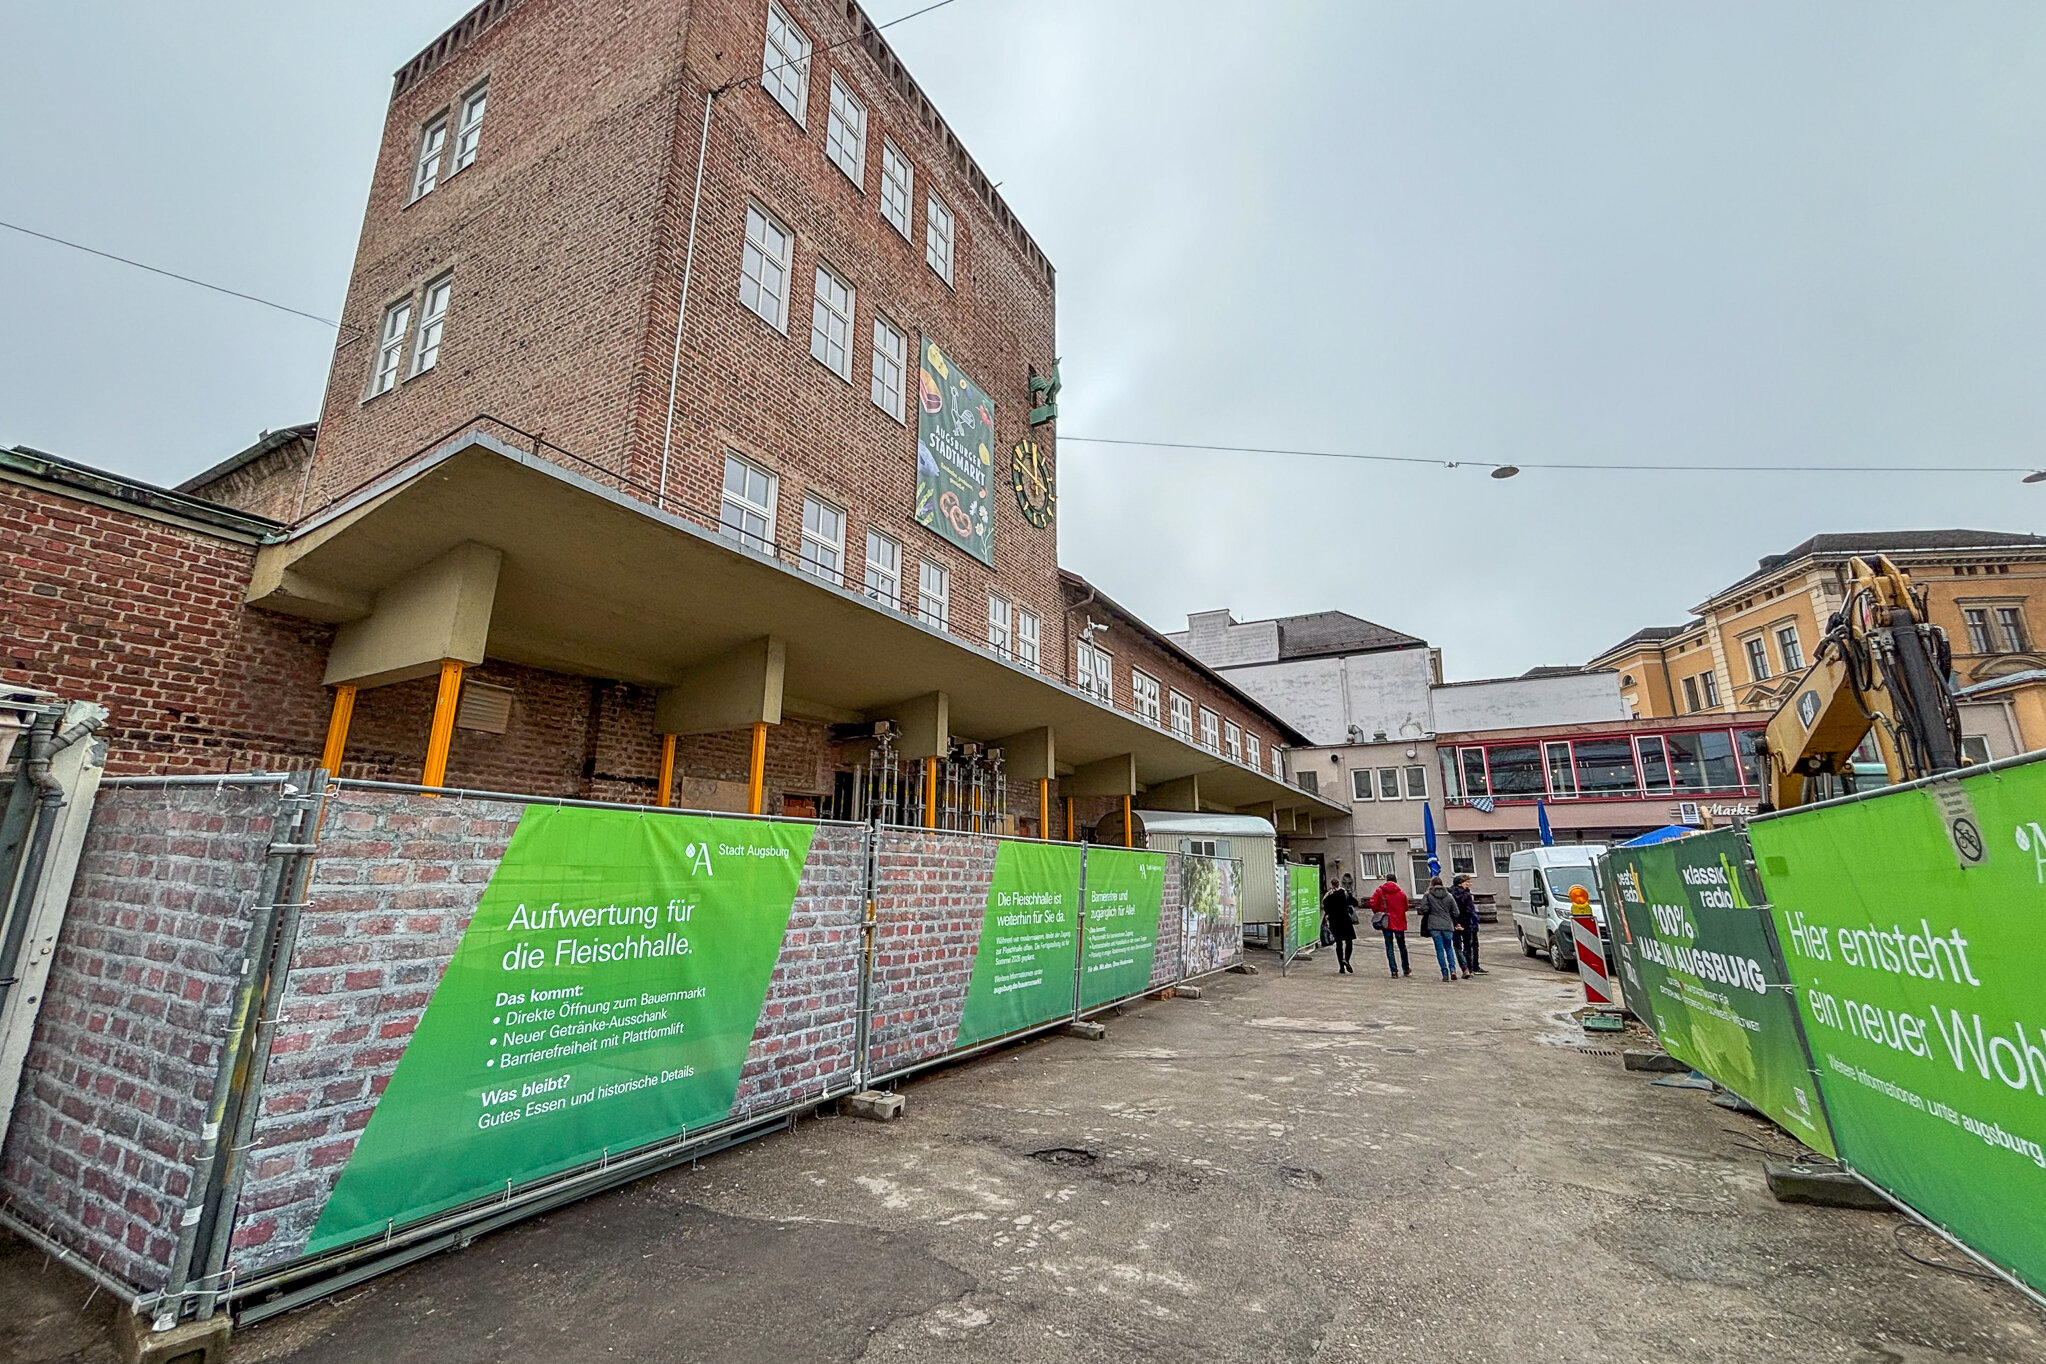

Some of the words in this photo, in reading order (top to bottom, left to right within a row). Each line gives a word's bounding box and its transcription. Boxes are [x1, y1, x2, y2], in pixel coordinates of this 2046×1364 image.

[930, 432, 985, 486] STADTMARKT
[936, 425, 981, 469] AUGSBURGER
[719, 844, 744, 856] Stadt
[746, 844, 789, 859] Augsburg
[507, 903, 659, 931] Aufwertung
[667, 900, 695, 922] für
[997, 911, 1031, 926] weiterhin
[1033, 911, 1043, 923] für
[1044, 910, 1055, 923] Sie
[998, 892, 1011, 906] Die
[1013, 892, 1053, 905] Fleischhalle
[1054, 892, 1062, 904] ist
[1700, 887, 1733, 909] radio
[1652, 904, 1694, 939] 100%
[502, 943, 545, 971] die
[555, 933, 693, 966] Fleischhalle.
[1660, 942, 1677, 969] IN
[1674, 945, 1767, 995] AUGSBURG
[1785, 910, 1832, 961] Hier
[1838, 918, 1981, 987] entsteht
[495, 992, 525, 1007] Das
[530, 985, 584, 1003] kommt:
[506, 1008, 555, 1026] Direkte
[559, 999, 610, 1018] Öffnung
[612, 997, 637, 1010] zum
[641, 986, 706, 1006] Bauernmarkt
[500, 1038, 598, 1068] Barrierefreiheit
[600, 1034, 619, 1048] mit
[622, 1022, 685, 1045] Plattformlift
[502, 1029, 545, 1047] Neuer
[549, 1007, 668, 1039] Getränke-Ausschank
[1808, 977, 1843, 1031] ein
[1843, 999, 1934, 1061] neuer
[1930, 1004, 2046, 1097] Woh
[478, 1109, 520, 1129] Gutes
[525, 1100, 566, 1116] Essen
[570, 1088, 595, 1106] und
[598, 1075, 658, 1100] historische
[661, 1065, 694, 1083] Details
[481, 1088, 517, 1107] Was
[522, 1074, 570, 1098] bleibt?
[1826, 1053, 1857, 1081] Weitere
[1855, 1065, 1926, 1112] Informationen
[1927, 1099, 1961, 1127] unter
[1961, 1114, 2046, 1169] augsburg
